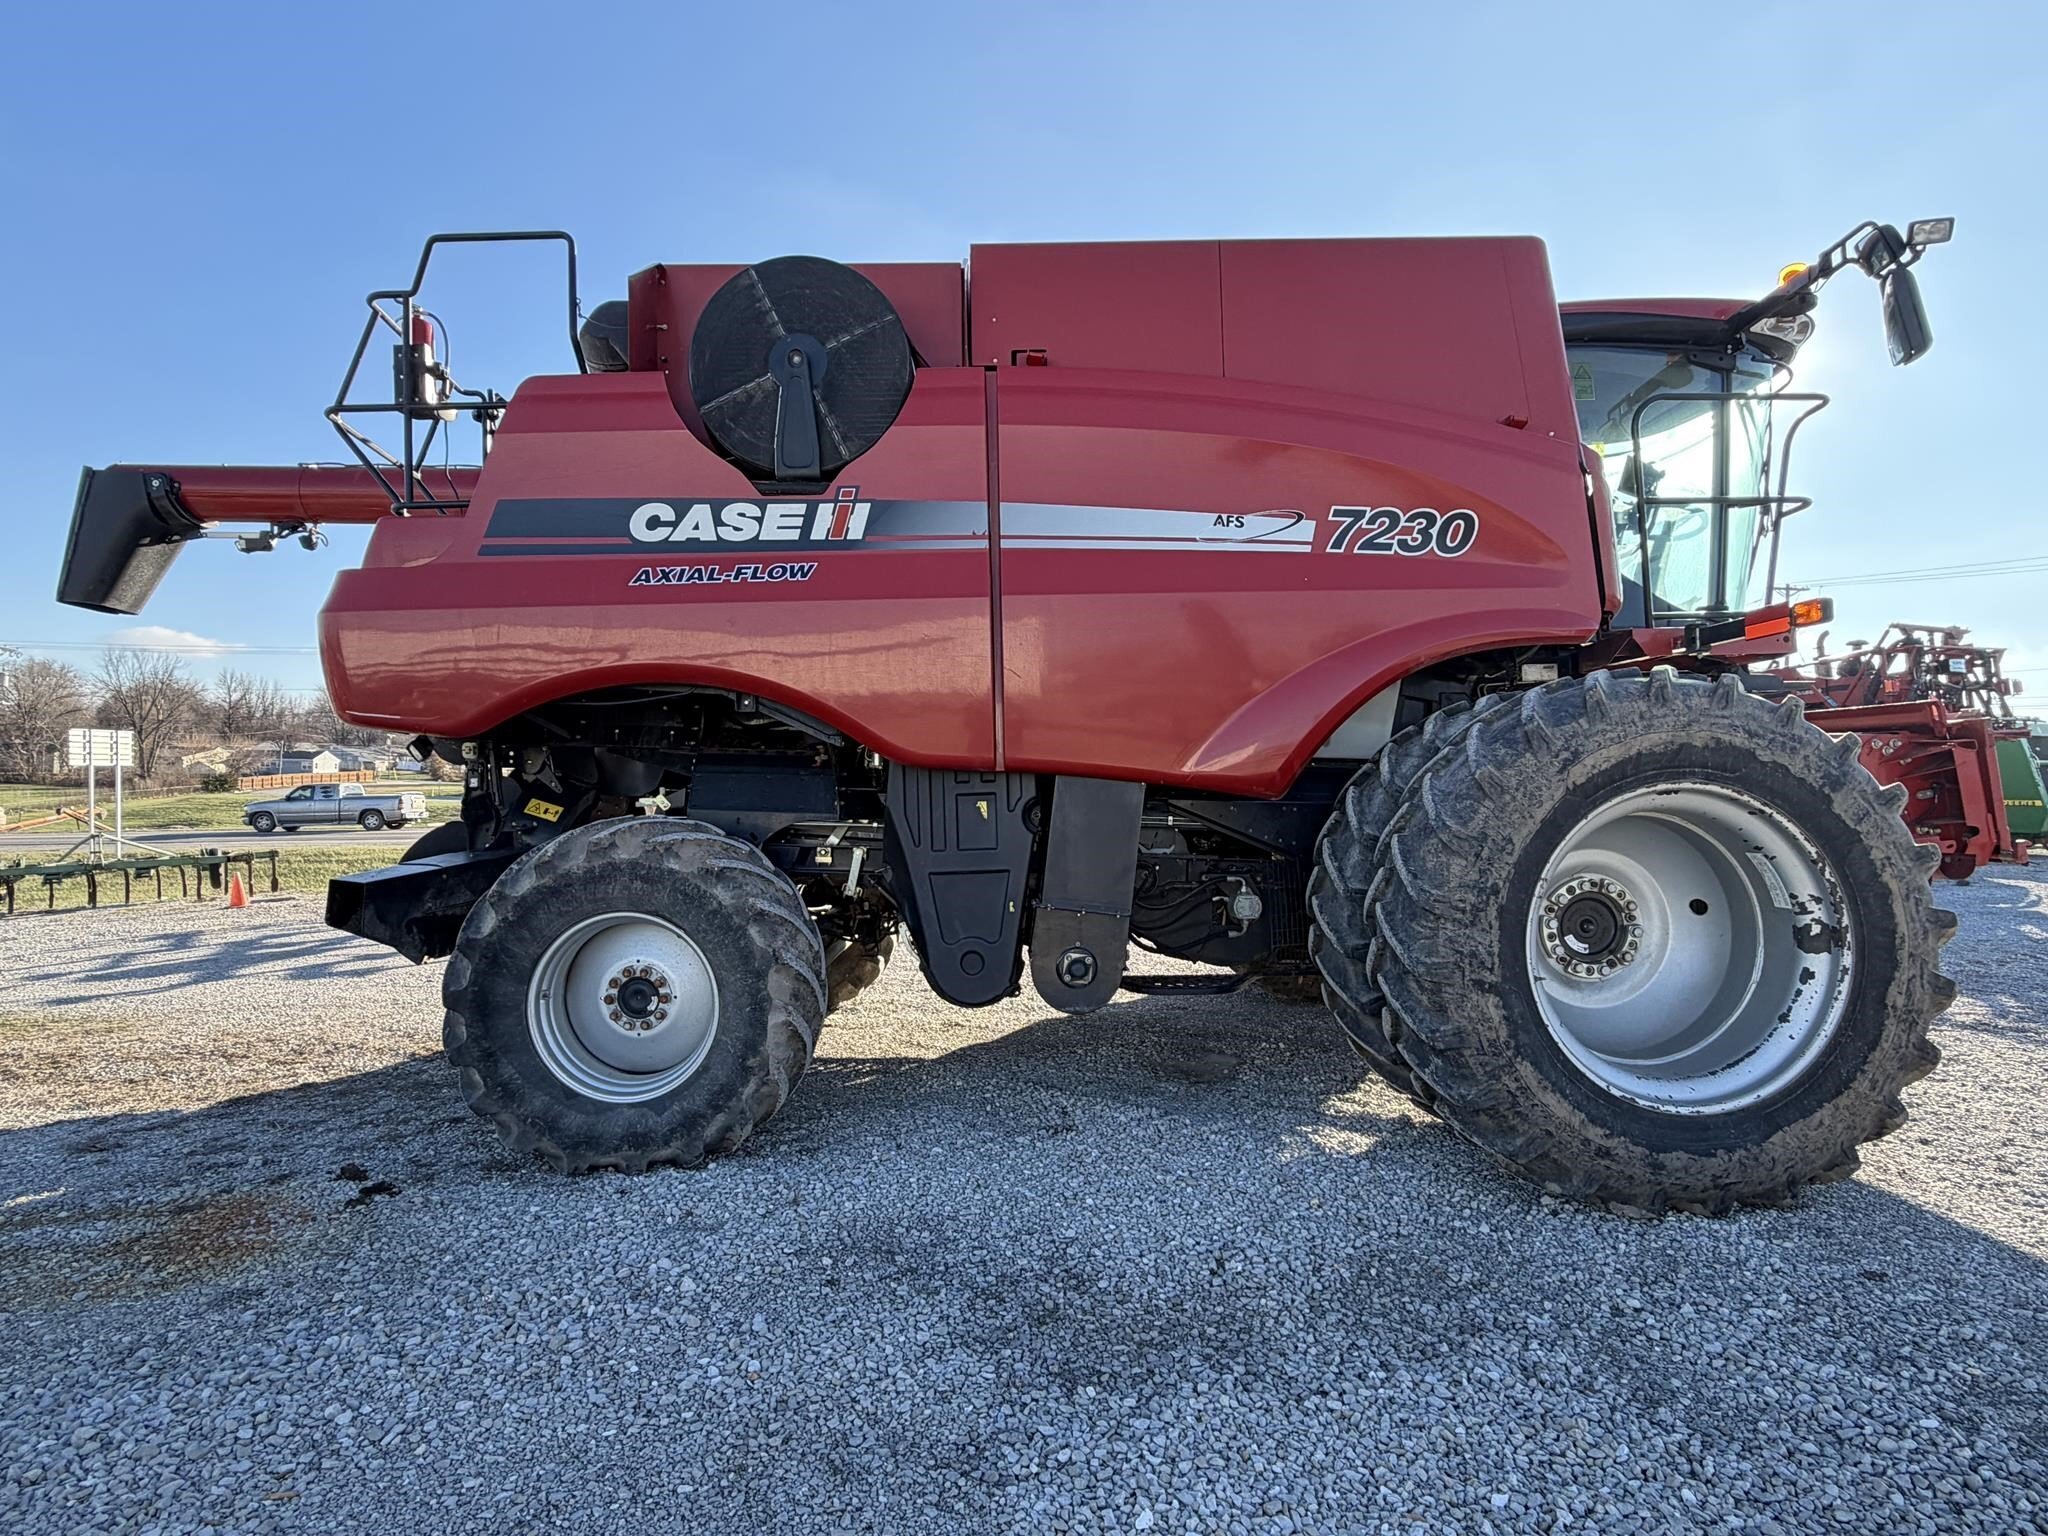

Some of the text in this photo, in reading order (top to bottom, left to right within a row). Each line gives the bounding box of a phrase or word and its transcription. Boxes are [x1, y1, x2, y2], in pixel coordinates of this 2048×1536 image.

[629, 502, 807, 542] CASE
[1213, 514, 1245, 528] AFS
[1326, 505, 1479, 557] 7230
[628, 562, 818, 586] AXIAL-FLOW
